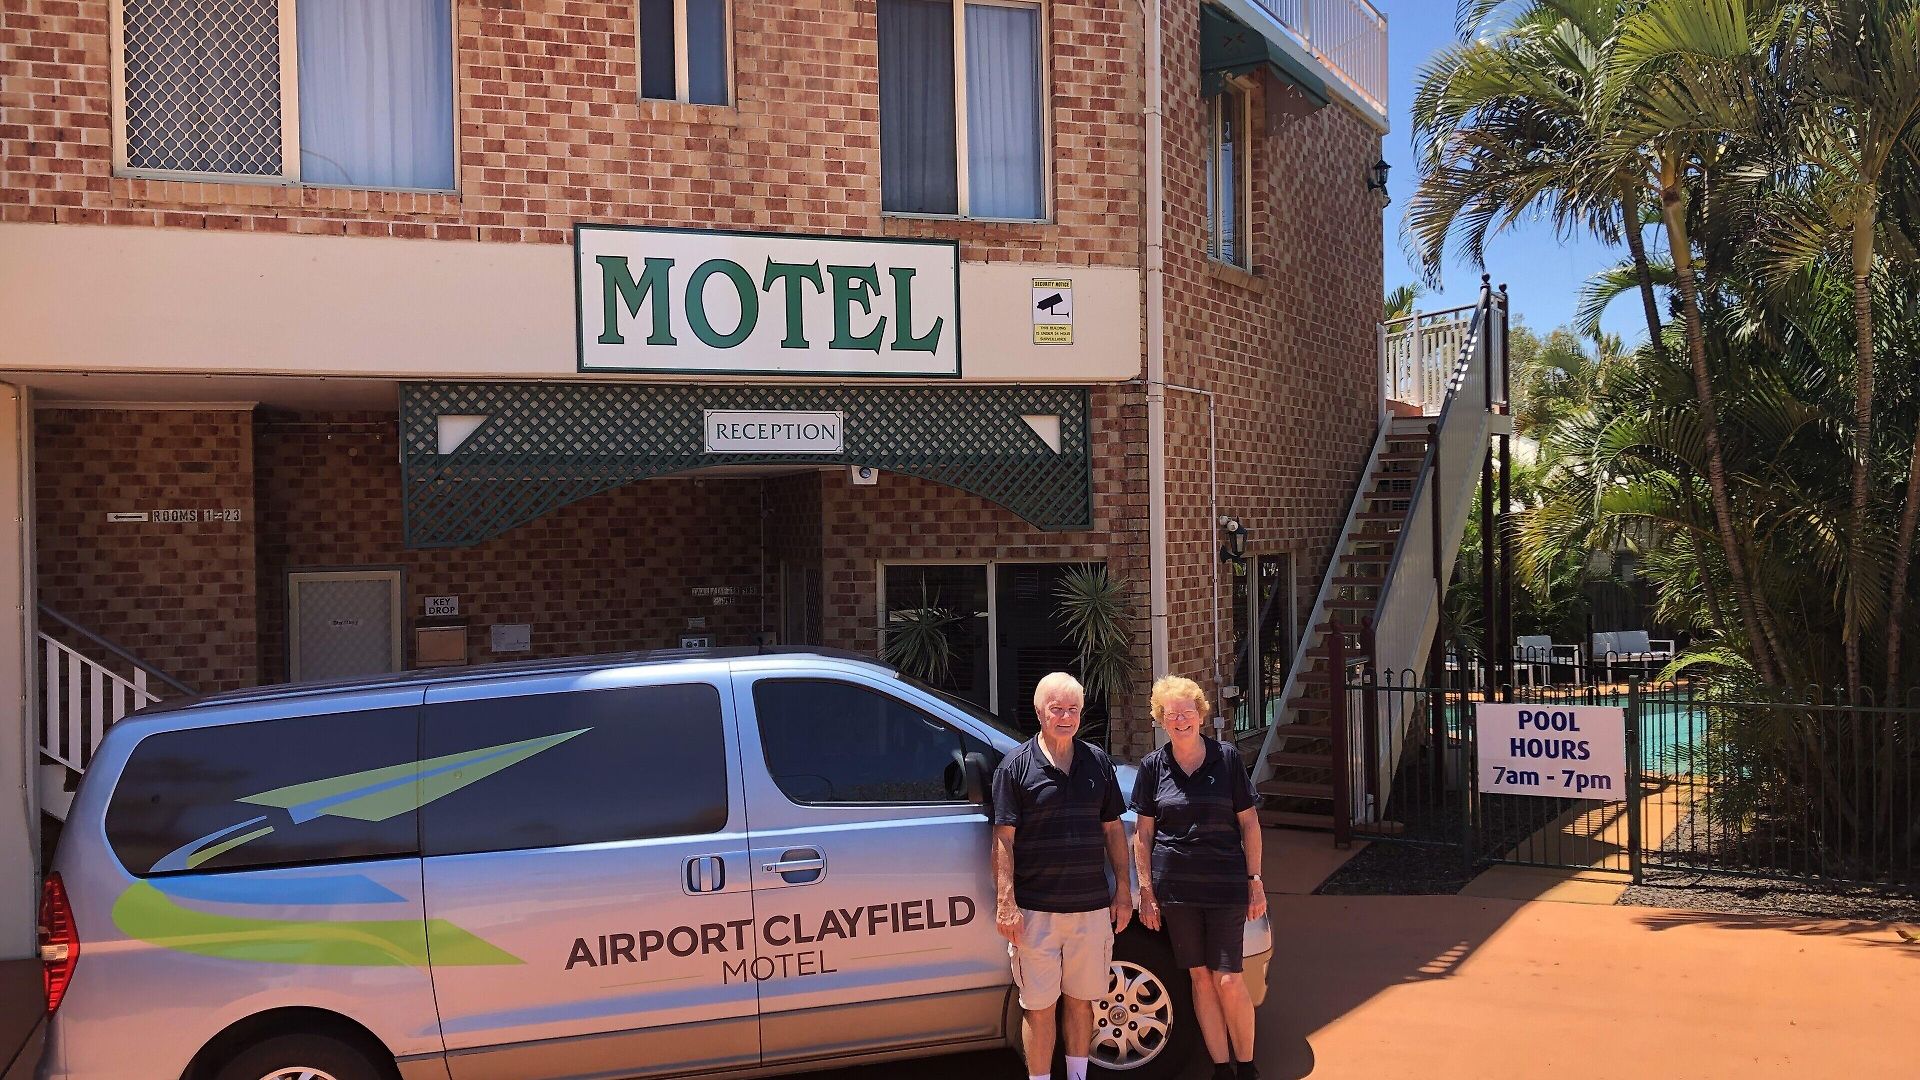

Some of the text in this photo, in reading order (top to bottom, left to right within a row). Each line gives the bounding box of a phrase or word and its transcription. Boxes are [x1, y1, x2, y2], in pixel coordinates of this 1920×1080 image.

[595, 254, 944, 356] MOTEL
[716, 422, 836, 442] RECEPTION
[153, 510, 197, 522] ROOMS
[428, 606, 456, 615] DROP
[433, 598, 451, 606] KEY
[1518, 710, 1580, 732] POOL
[1510, 737, 1590, 761] HOURS
[1492, 766, 1540, 786] 7am
[1561, 769, 1612, 793] 7pm
[564, 895, 977, 971] AIRPORT CLAYFIELD
[721, 949, 838, 985] MOTEL
